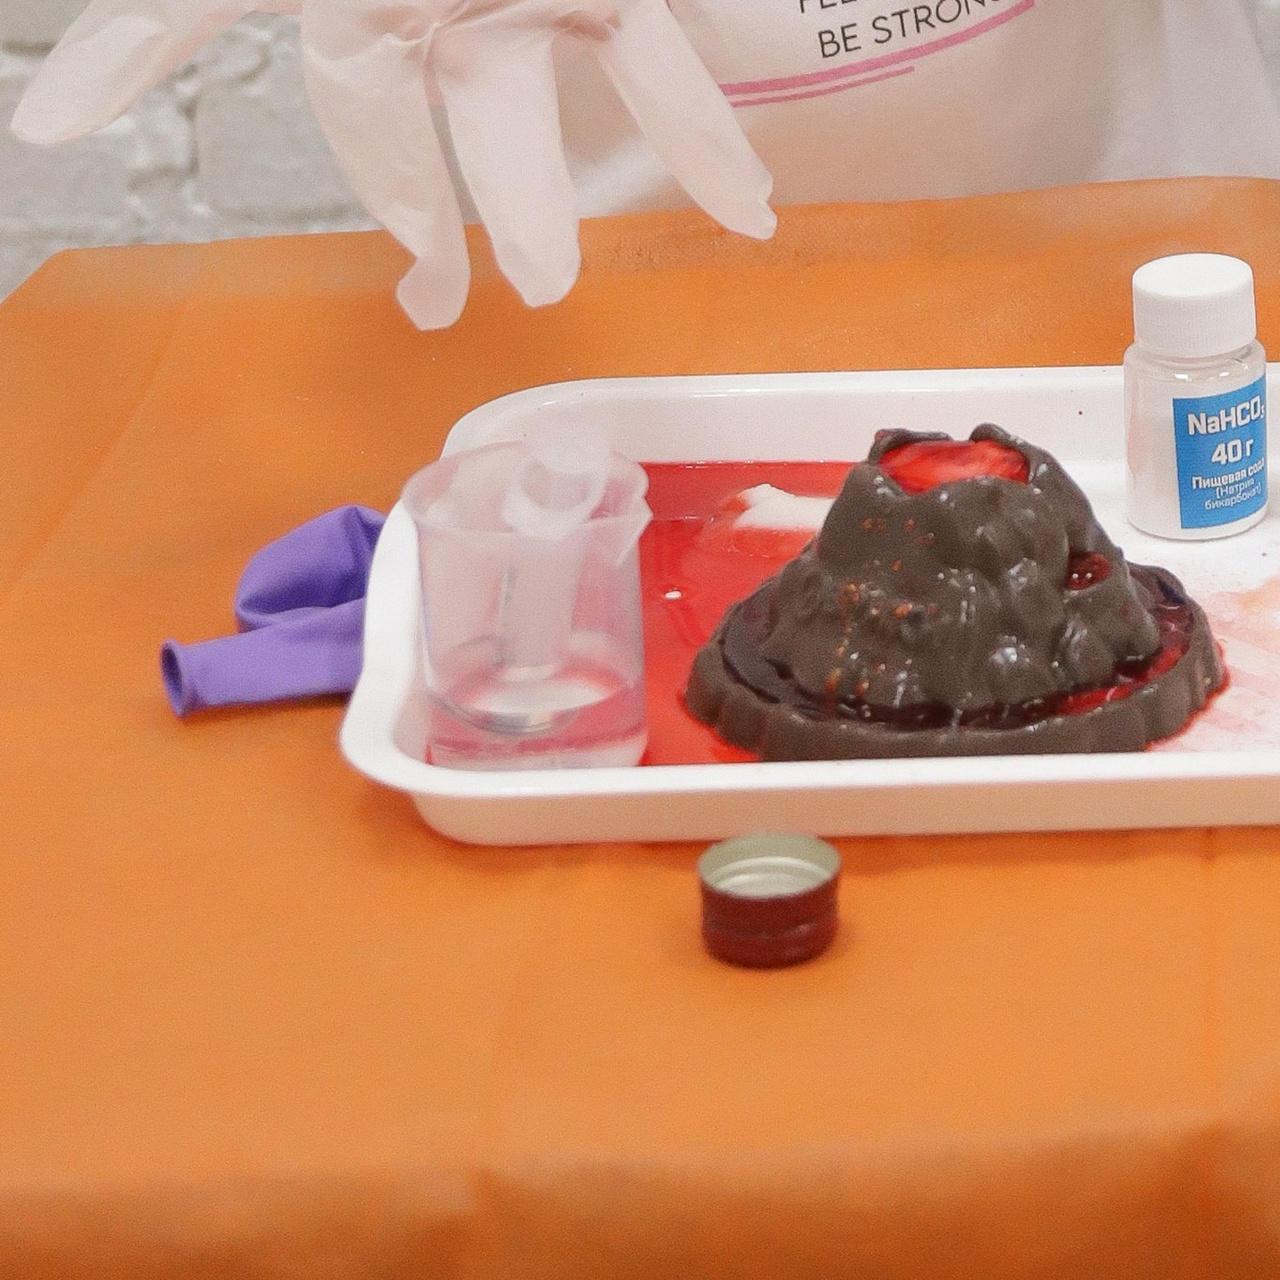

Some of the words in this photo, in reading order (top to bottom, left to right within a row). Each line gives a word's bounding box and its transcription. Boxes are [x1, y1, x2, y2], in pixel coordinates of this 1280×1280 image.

[818, 22, 862, 58] BE
[1211, 438, 1243, 466] 40
[1192, 470, 1247, 489] Пищевая
